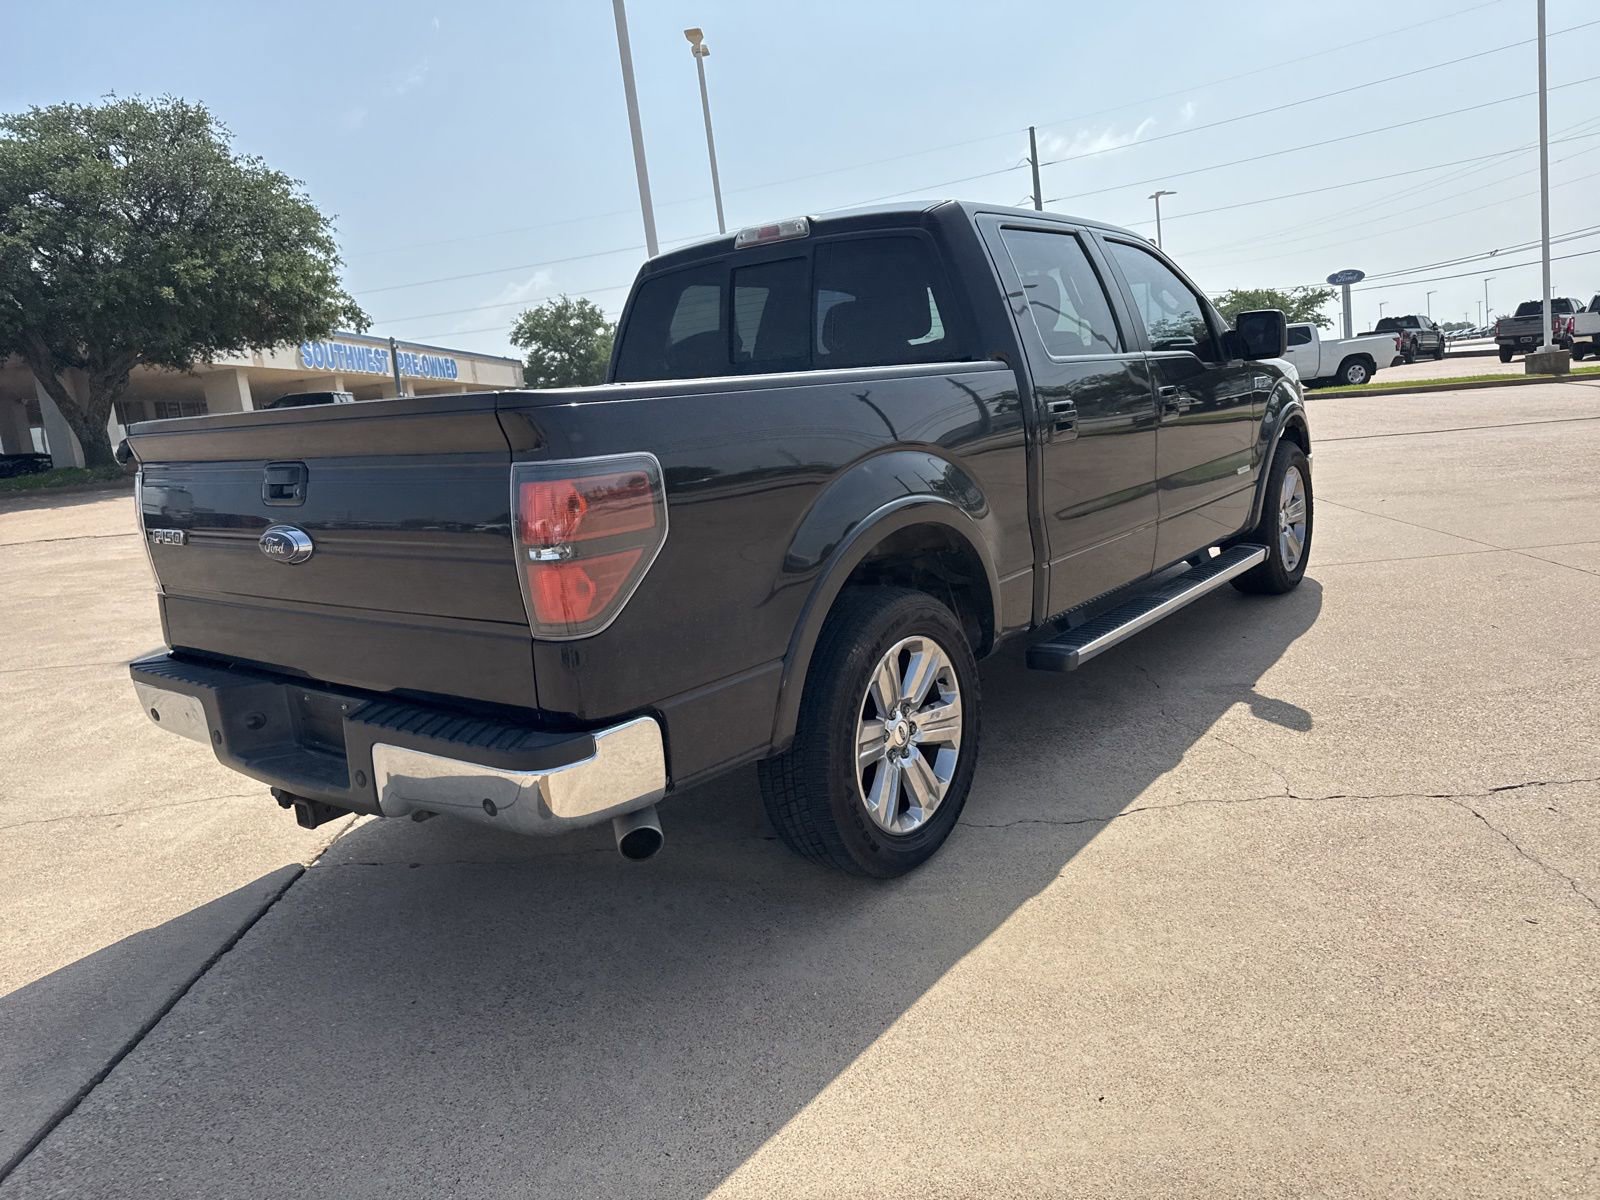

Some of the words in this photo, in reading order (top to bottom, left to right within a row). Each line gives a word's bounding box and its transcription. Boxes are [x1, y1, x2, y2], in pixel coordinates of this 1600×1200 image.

[301, 341, 389, 374] SOUTHWEST
[397, 351, 458, 379] PRE-OWNED
[264, 536, 286, 555] Ford
